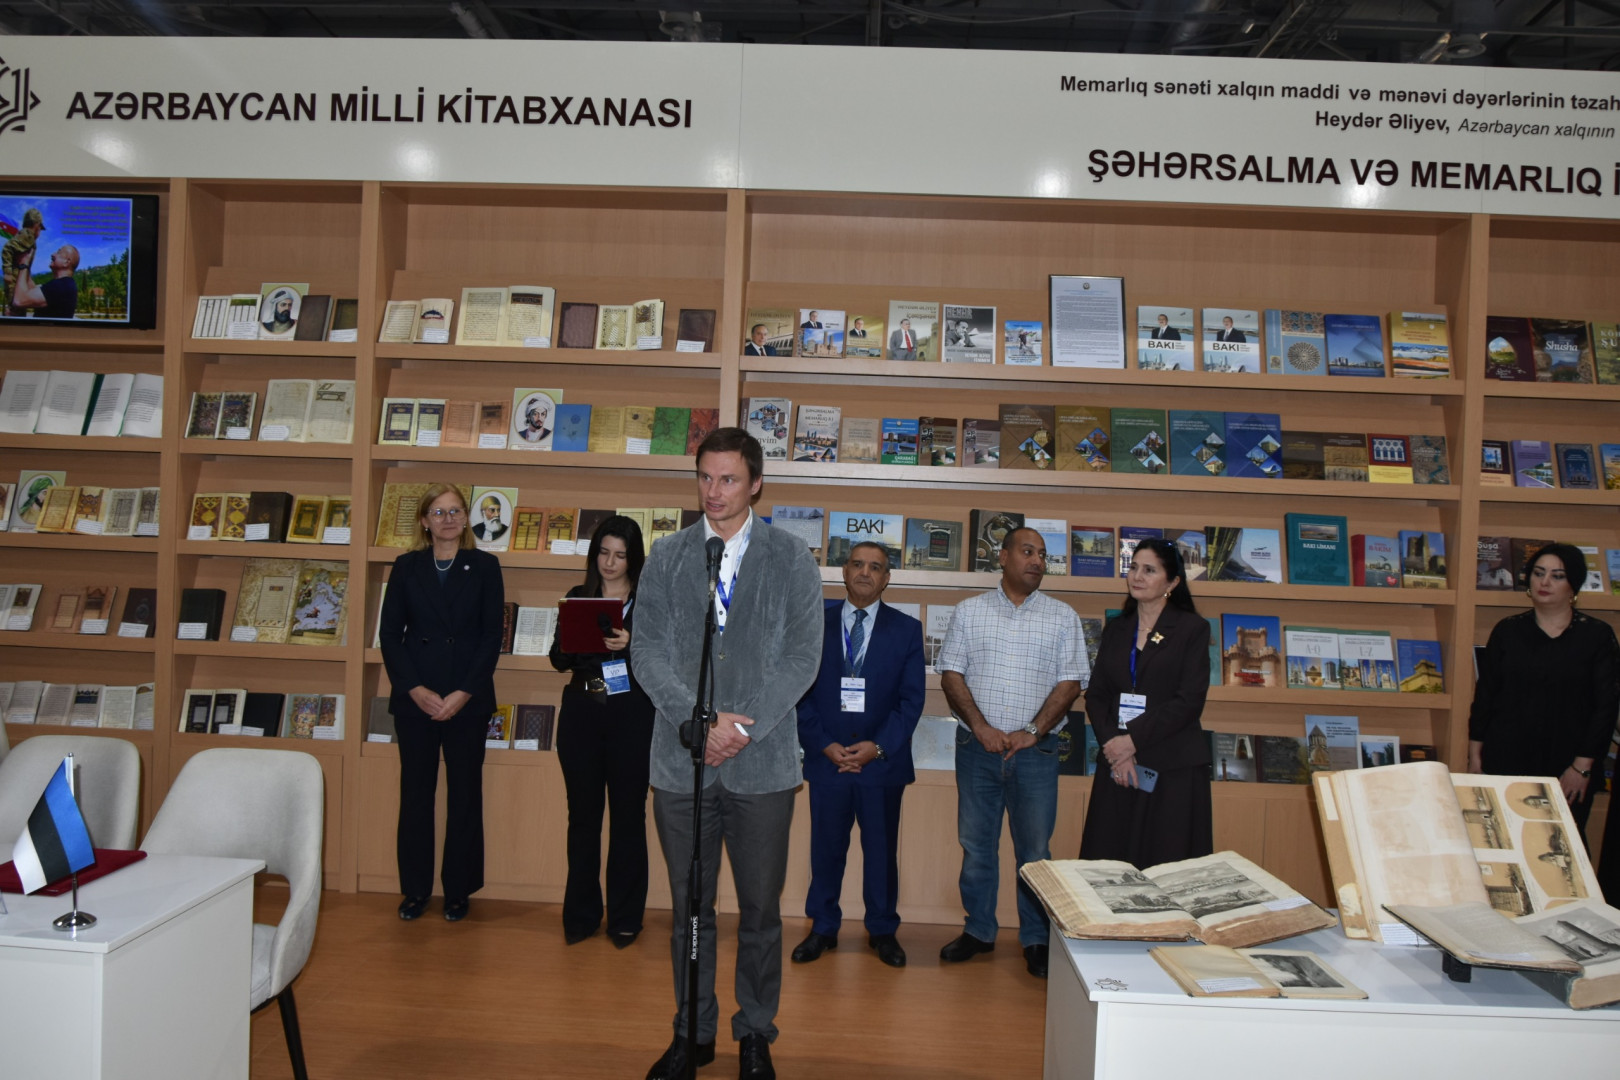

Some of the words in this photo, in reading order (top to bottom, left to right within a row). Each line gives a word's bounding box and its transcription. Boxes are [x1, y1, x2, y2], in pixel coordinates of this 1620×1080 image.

[1061, 75, 1147, 98] Memarlıq
[1153, 81, 1211, 96] sənəti
[1217, 83, 1275, 101] xalqın
[1281, 84, 1339, 100] maddi
[1348, 88, 1371, 101] və
[1379, 89, 1447, 104] mənəvi
[1453, 89, 1564, 110] dəyərlərinin
[66, 91, 317, 122] AZƏRBAYCAN
[330, 85, 424, 123] MİLLİ
[437, 86, 692, 129] KİTABXANASI
[1315, 110, 1383, 131] Heydər
[1388, 112, 1450, 135] Əliyev,
[1457, 117, 1550, 136] Azərbaycan
[1554, 122, 1616, 140] xalqının
[1087, 148, 1342, 189] ŞƏHƏRSALMA
[1349, 158, 1400, 187] VƏ
[1410, 160, 1603, 198] MEMARLIQ
[1148, 340, 1175, 350] BAKI
[1212, 342, 1240, 352] BAKI
[1545, 340, 1578, 352] Shusha
[847, 518, 884, 534] BAKI
